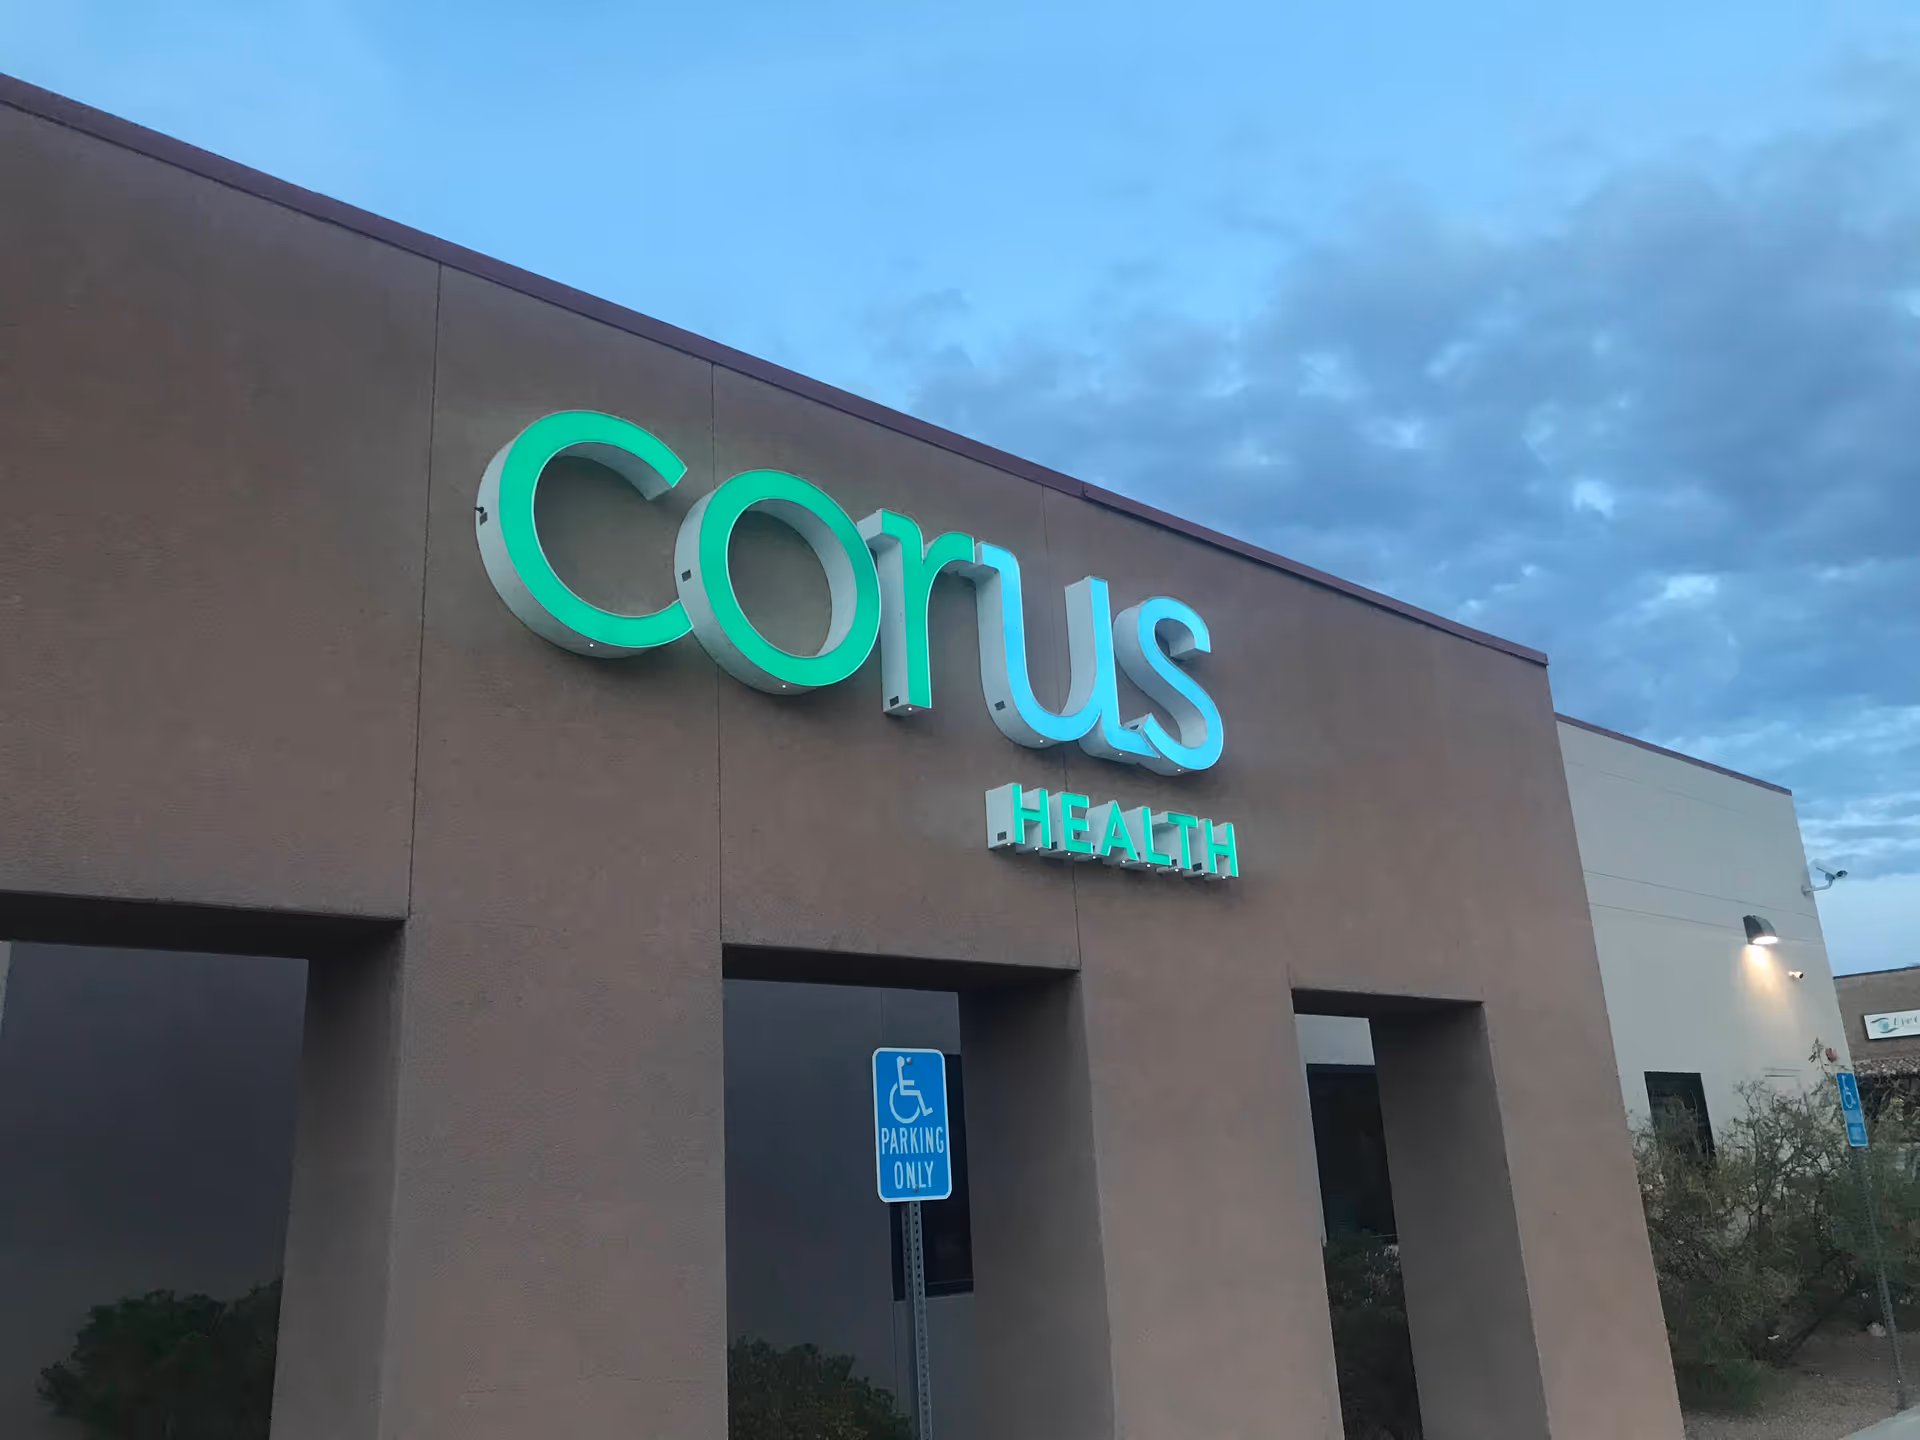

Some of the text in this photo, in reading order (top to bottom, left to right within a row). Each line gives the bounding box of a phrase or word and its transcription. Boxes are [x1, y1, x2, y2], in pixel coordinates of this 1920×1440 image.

[988, 783, 1239, 877] HEALTH
[881, 1126, 944, 1154] PARKING
[894, 1161, 934, 1189] ONLY
